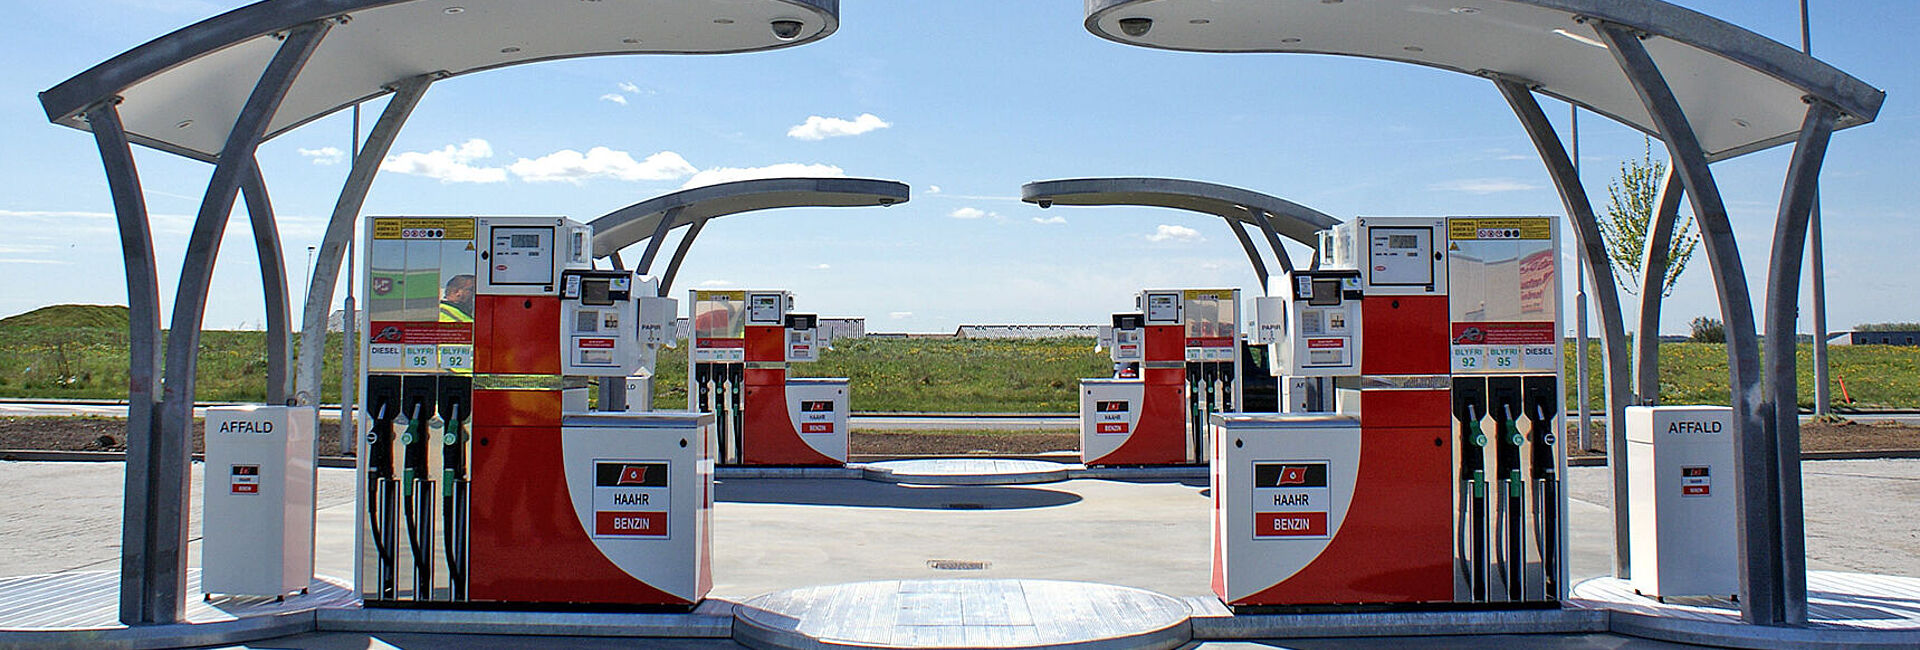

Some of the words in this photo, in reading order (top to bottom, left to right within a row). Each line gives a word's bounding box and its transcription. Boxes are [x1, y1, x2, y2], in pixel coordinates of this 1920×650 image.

[556, 218, 563, 227] 3
[1360, 219, 1367, 227] 2
[413, 356, 427, 365] 95
[449, 356, 462, 366] 92
[1462, 357, 1475, 367] 92
[1497, 357, 1511, 366] 95
[220, 421, 273, 433] AFFALD
[1668, 421, 1722, 433] AFFALD
[614, 493, 649, 505] HAAHR
[1274, 494, 1309, 506] HAAHR
[614, 518, 650, 530] BENZIN
[1274, 518, 1310, 530] BENZIN
